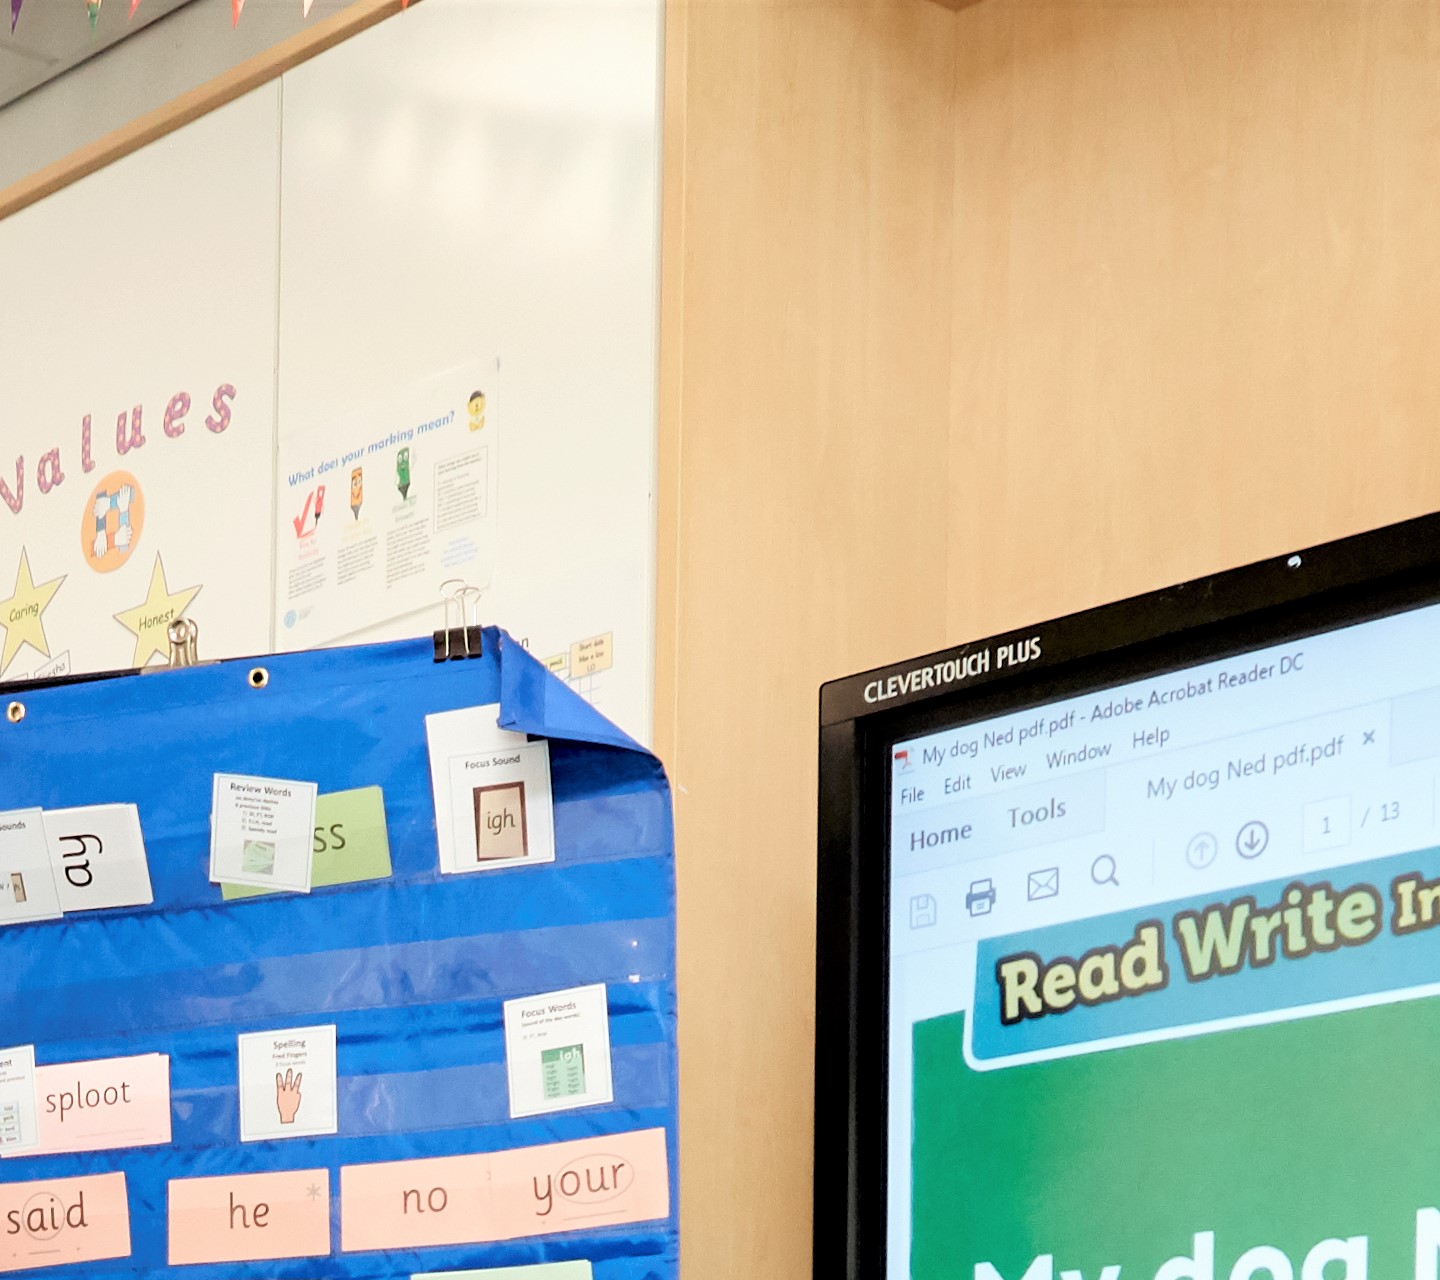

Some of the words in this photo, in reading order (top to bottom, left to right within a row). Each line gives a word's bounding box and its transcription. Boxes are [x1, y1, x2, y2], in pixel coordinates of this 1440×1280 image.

[288, 469, 314, 487] What
[318, 457, 339, 474] does
[342, 448, 365, 467] your
[367, 427, 414, 455] marking
[417, 410, 455, 435] mean?
[9, 602, 40, 622] Caring
[138, 608, 175, 631] Honest
[863, 648, 990, 703] CLEVERTOUCH
[996, 636, 1042, 669] PLUS
[923, 746, 946, 766] My
[950, 736, 979, 762] dog
[983, 728, 1014, 749] Ned
[1018, 710, 1076, 746] pdf.pdf
[1090, 696, 1144, 723] Adobe
[1147, 676, 1214, 708] Acrobat
[1218, 664, 1275, 691] Reader
[1280, 652, 1305, 674] DC
[465, 760, 490, 769] Focus
[492, 754, 521, 766] Sound
[901, 785, 925, 804] File
[944, 775, 972, 795] Edit
[990, 763, 1028, 784] View
[1046, 740, 1113, 770] Window
[1132, 726, 1171, 749] Help
[1146, 778, 1178, 800] My
[1183, 768, 1220, 790] dog
[1227, 754, 1266, 780] Ned
[1273, 734, 1345, 775] pdf.pdf
[230, 783, 262, 794] Review
[264, 787, 292, 798] Words
[1380, 800, 1401, 822] 13
[487, 808, 516, 836] igh
[910, 819, 974, 852] Home
[1008, 797, 1067, 829] Tools
[58, 834, 103, 887] ay
[1001, 926, 1163, 1022] Read
[1178, 886, 1377, 977] Write
[521, 1008, 545, 1018] Focus
[548, 1002, 577, 1013] Words
[273, 1040, 306, 1050] Spelling
[46, 1081, 132, 1122] sploot
[403, 1187, 448, 1214] no
[533, 1163, 625, 1216] your
[7, 1191, 88, 1235] said
[229, 1192, 269, 1229] he
